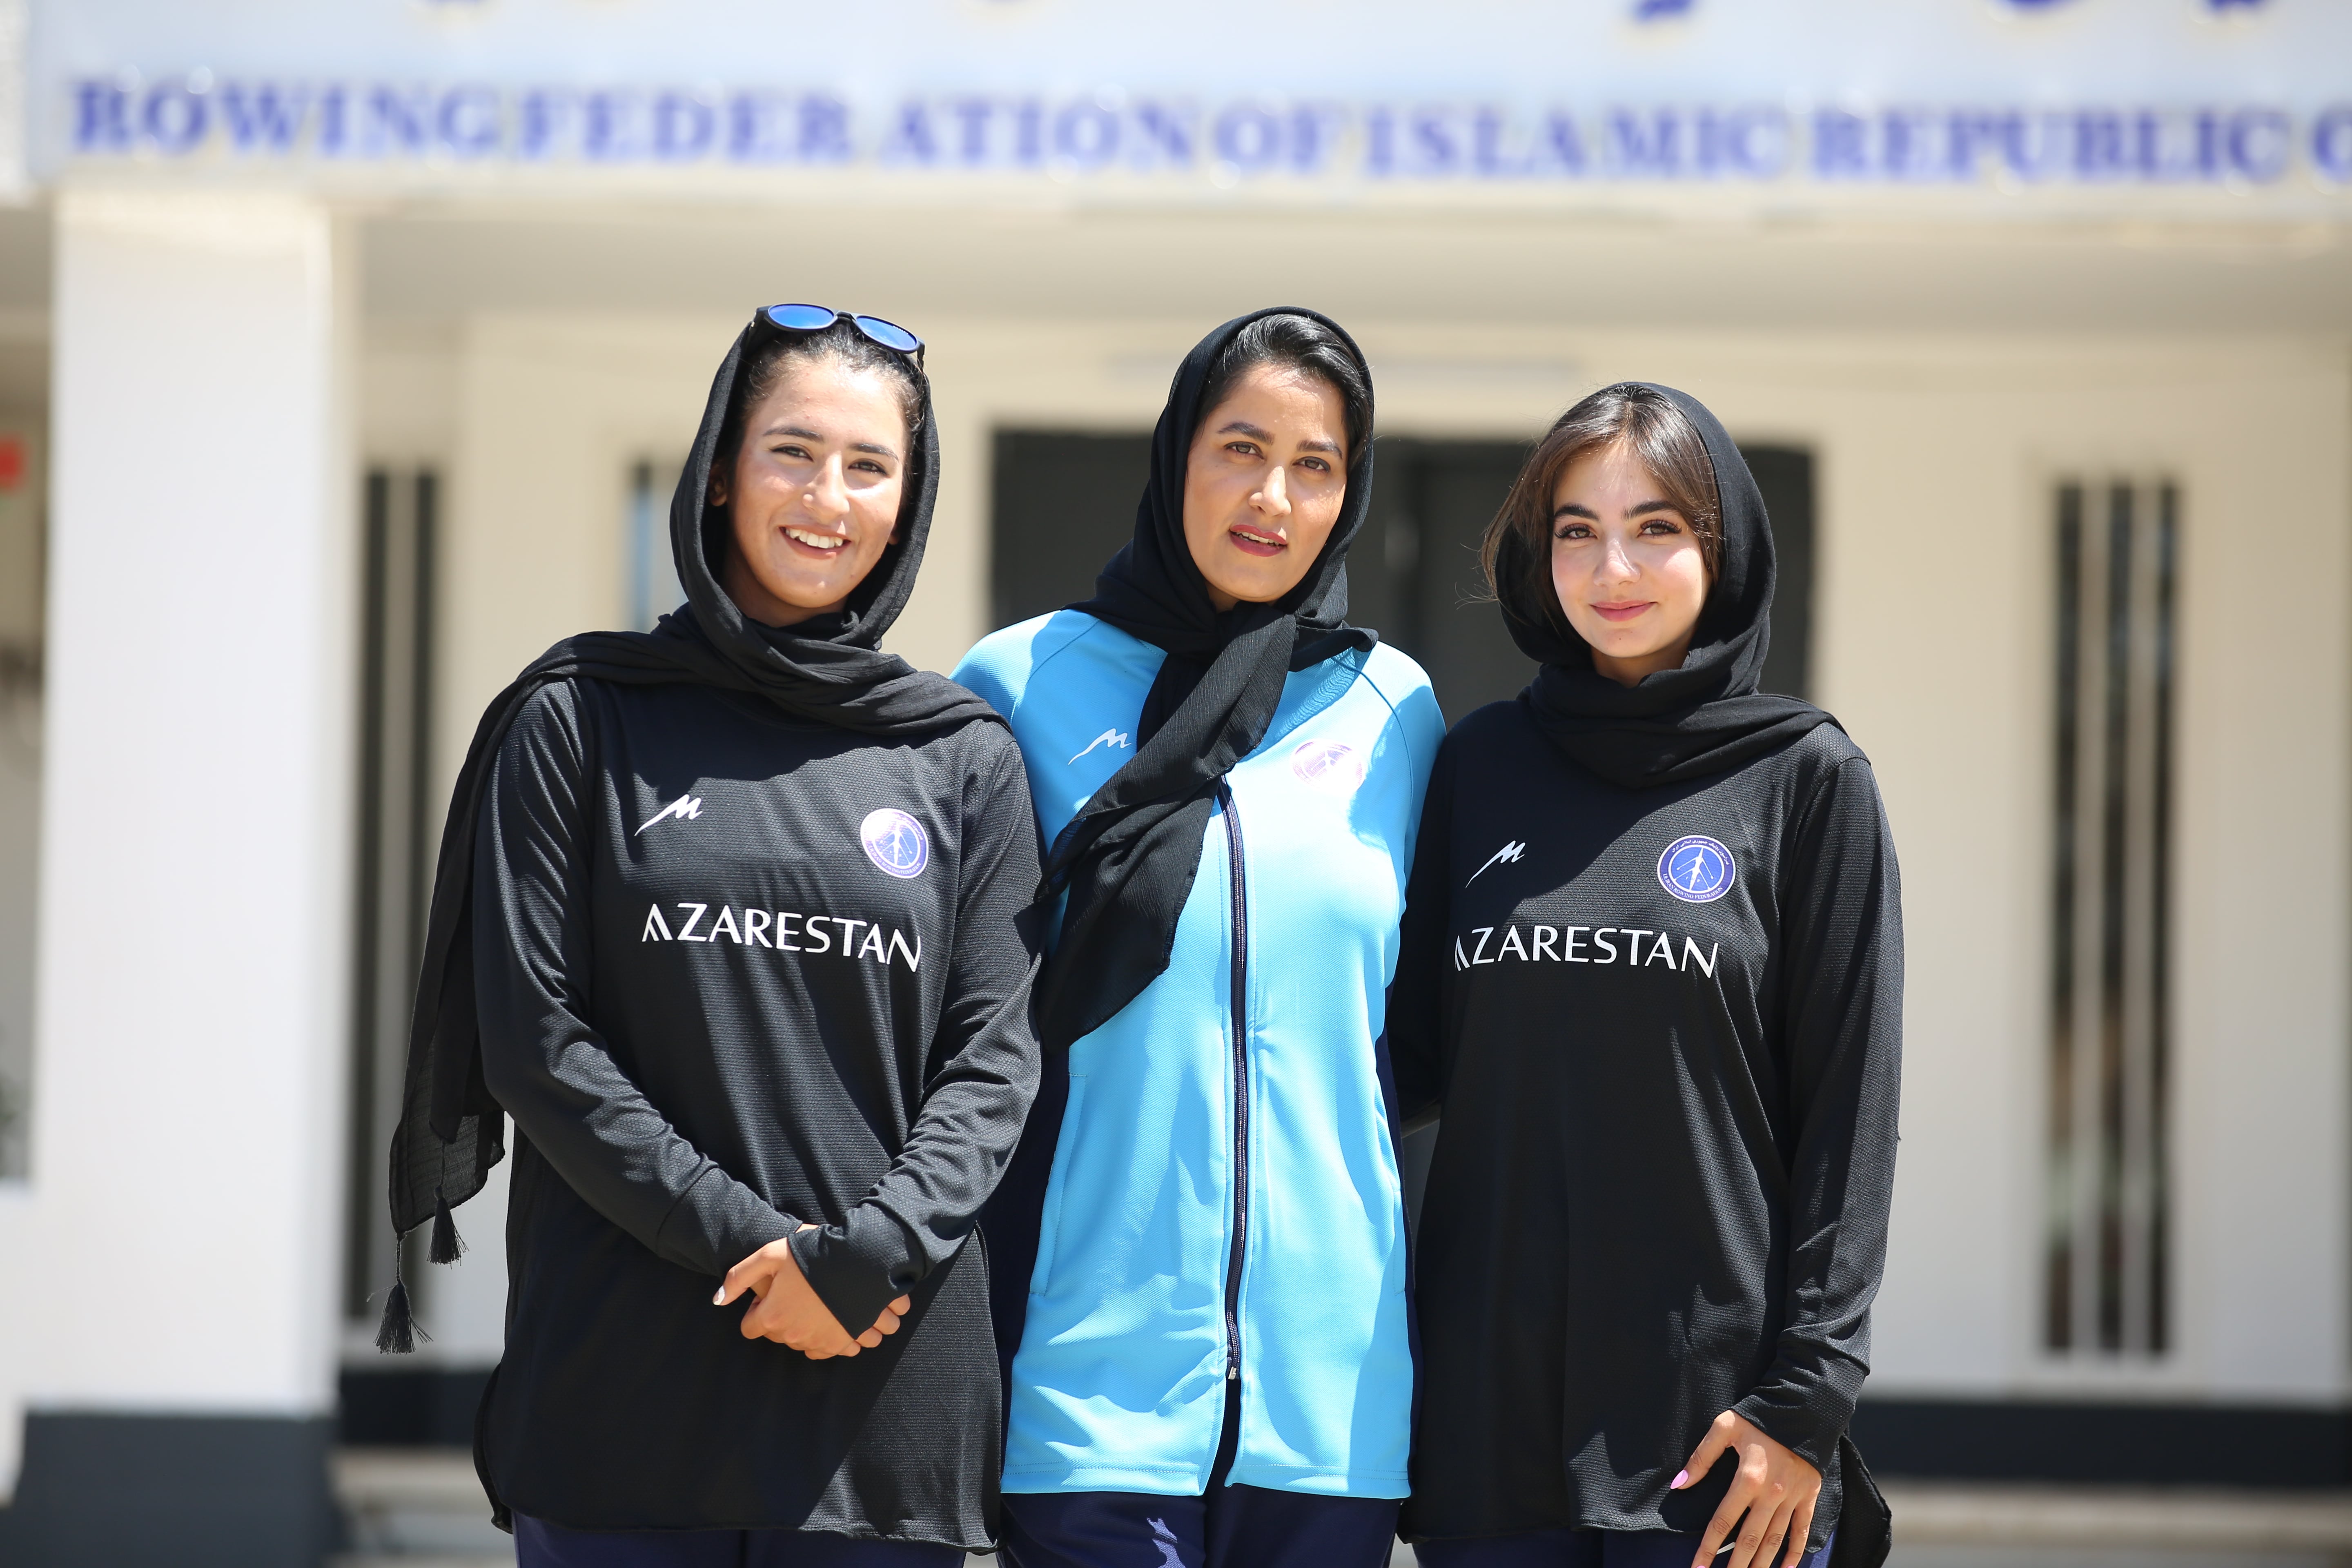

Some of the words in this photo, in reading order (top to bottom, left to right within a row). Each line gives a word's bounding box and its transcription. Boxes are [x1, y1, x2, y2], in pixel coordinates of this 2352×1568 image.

[69, 80, 504, 157] ROWING
[1212, 99, 1330, 176] OF
[1362, 102, 1789, 180] ISLAMIC
[1810, 105, 2292, 184] REPUBLIC
[1674, 887, 1694, 899] ROWING
[1695, 886, 1723, 900] FEDERATION
[641, 902, 921, 973] AZARESTAN
[1454, 924, 1719, 979] AZARESTAN
